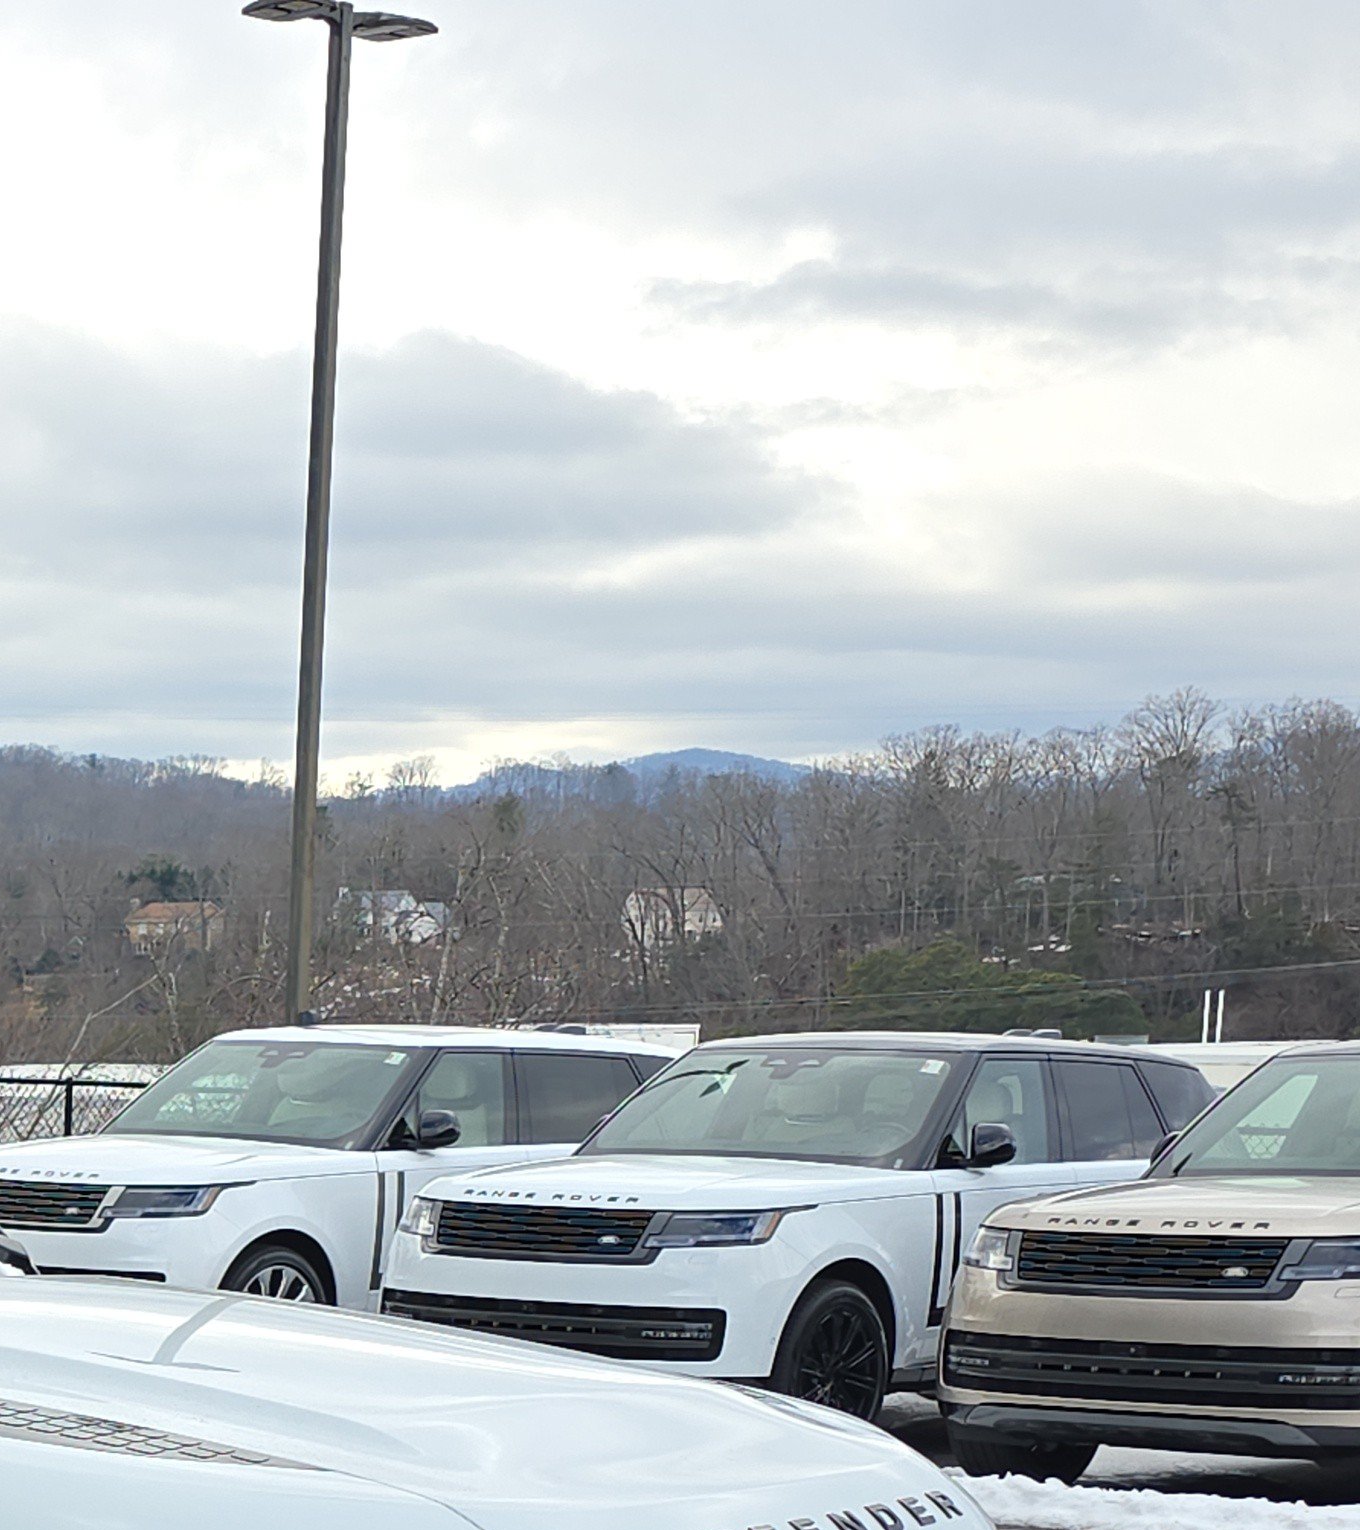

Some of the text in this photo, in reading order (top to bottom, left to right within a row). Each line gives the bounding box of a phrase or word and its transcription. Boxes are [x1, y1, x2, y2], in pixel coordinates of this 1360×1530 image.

[31, 1170, 100, 1179] ROVER
[464, 1189, 639, 1204] RANGE ROVER
[1048, 1217, 1270, 1230] RANGE ROVER
